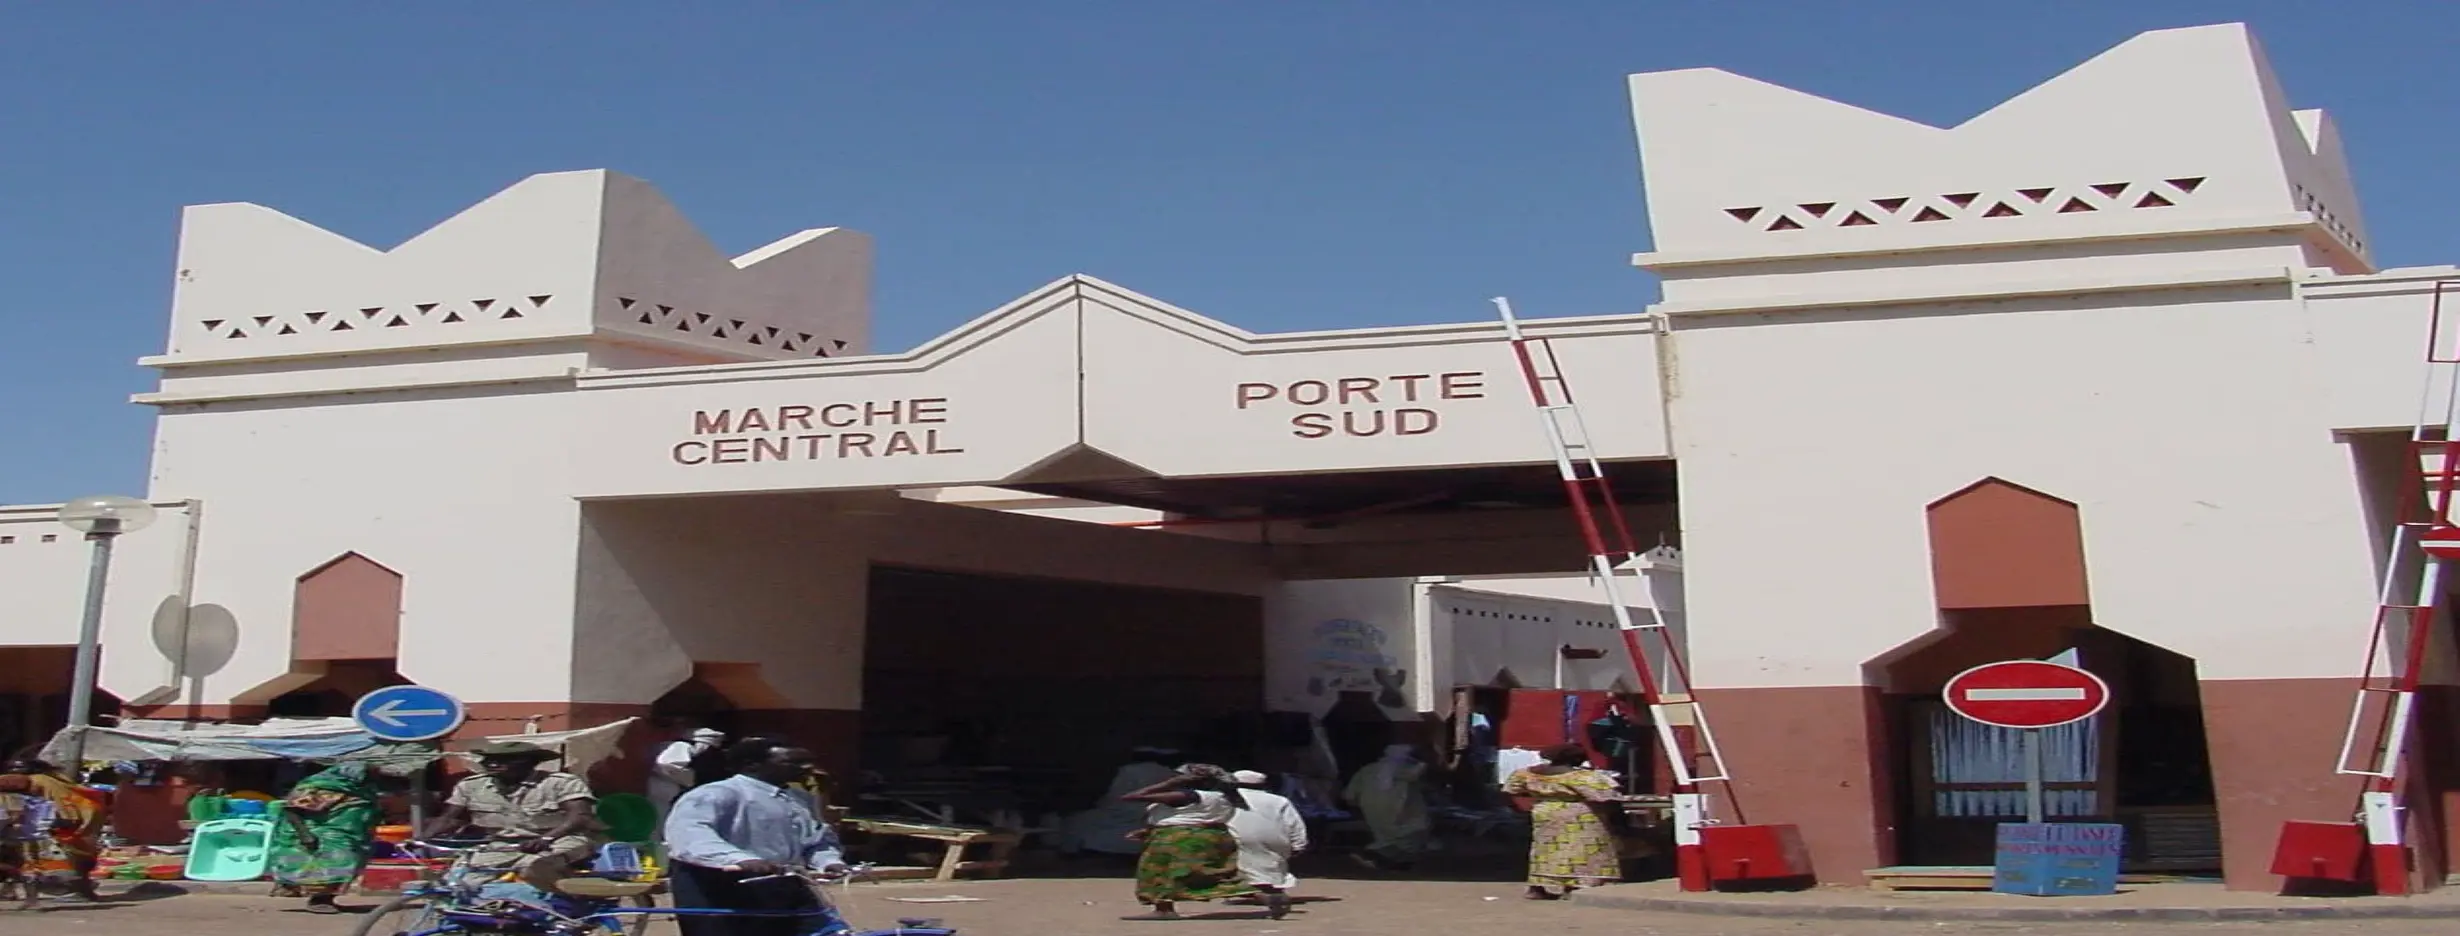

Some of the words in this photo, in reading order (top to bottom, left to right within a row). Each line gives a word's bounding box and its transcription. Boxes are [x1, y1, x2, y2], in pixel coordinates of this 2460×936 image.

[1237, 371, 1485, 410] PORTE
[693, 397, 948, 435] MARCHE
[1290, 408, 1439, 439] SUD
[672, 430, 965, 465] CENTRAL
